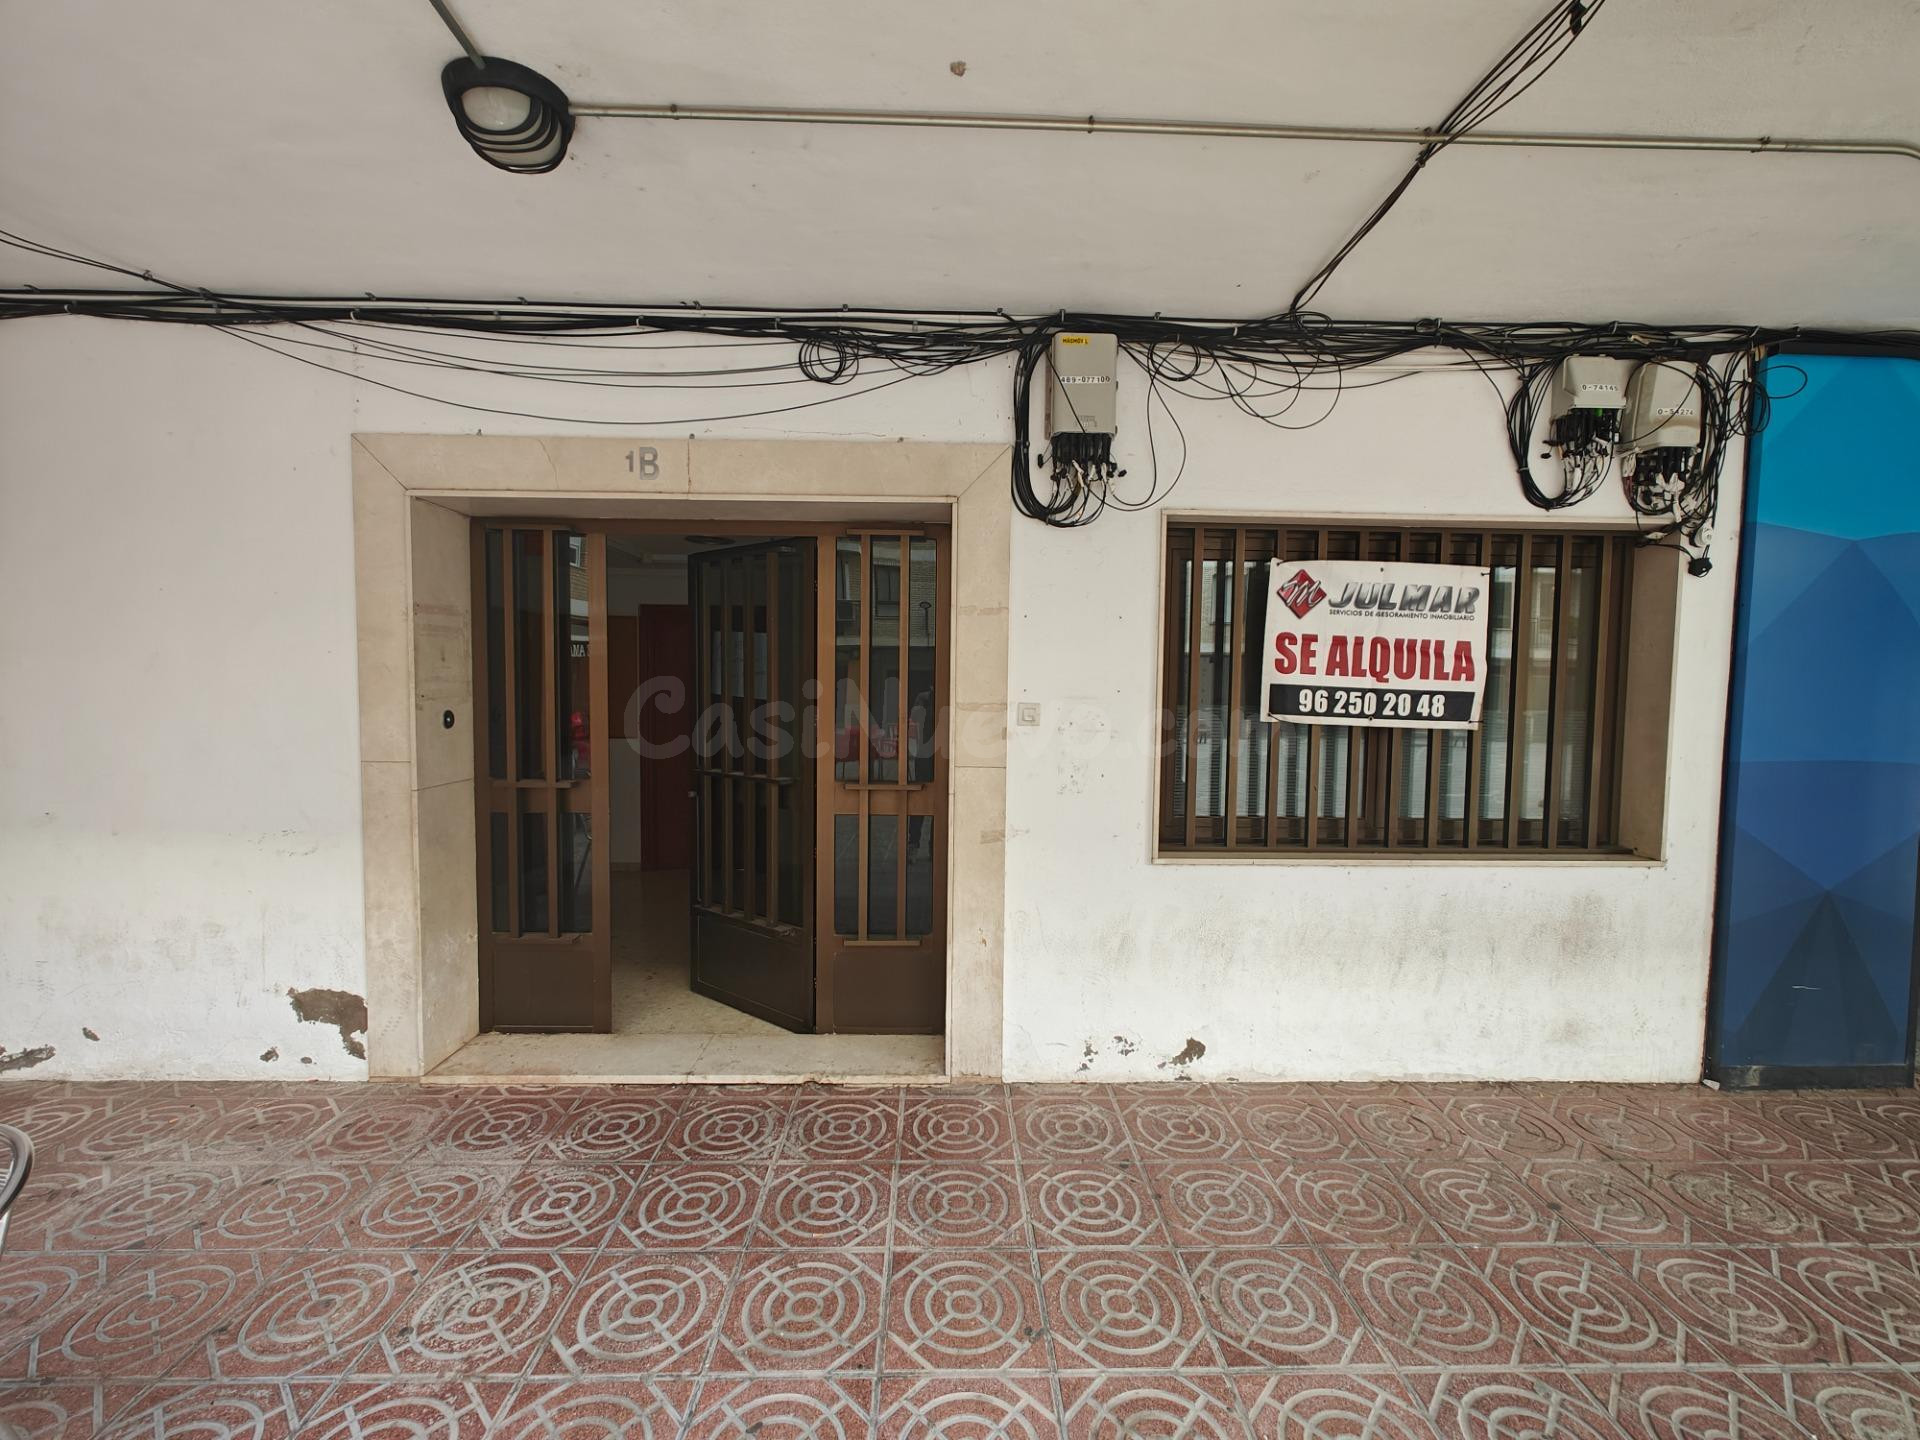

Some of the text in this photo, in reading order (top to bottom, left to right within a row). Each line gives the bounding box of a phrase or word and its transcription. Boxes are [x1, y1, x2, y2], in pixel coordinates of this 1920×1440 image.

[625, 446, 660, 481] 1B
[1328, 582, 1480, 614] JULMAR
[1329, 608, 1362, 617] SERVICIOS
[1429, 613, 1475, 622] INMOBILIARIO
[1274, 631, 1475, 683] SE ALQUILA
[1299, 689, 1446, 718] 96 250 20 48
